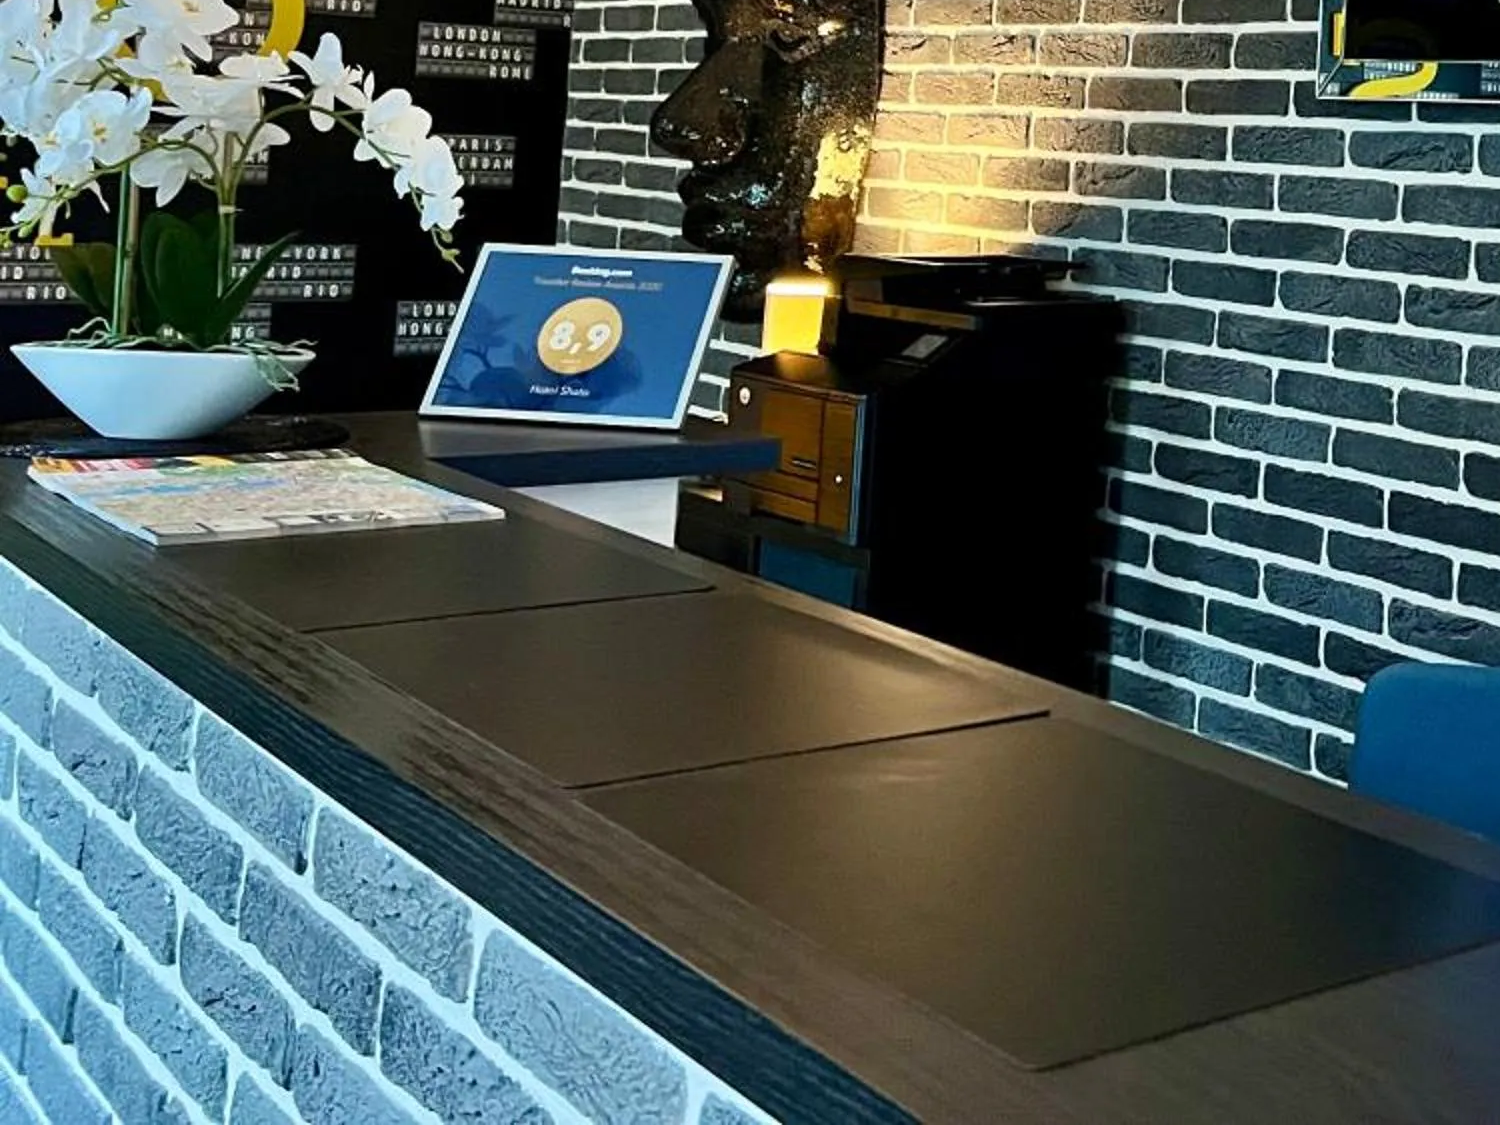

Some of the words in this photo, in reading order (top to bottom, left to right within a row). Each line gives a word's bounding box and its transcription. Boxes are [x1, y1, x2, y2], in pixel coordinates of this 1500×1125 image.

[433, 26, 500, 42] LONDON
[419, 44, 522, 62] HONG-KONG
[26, 286, 66, 300] RIO
[303, 284, 339, 298] RIO
[413, 303, 456, 317] LOND
